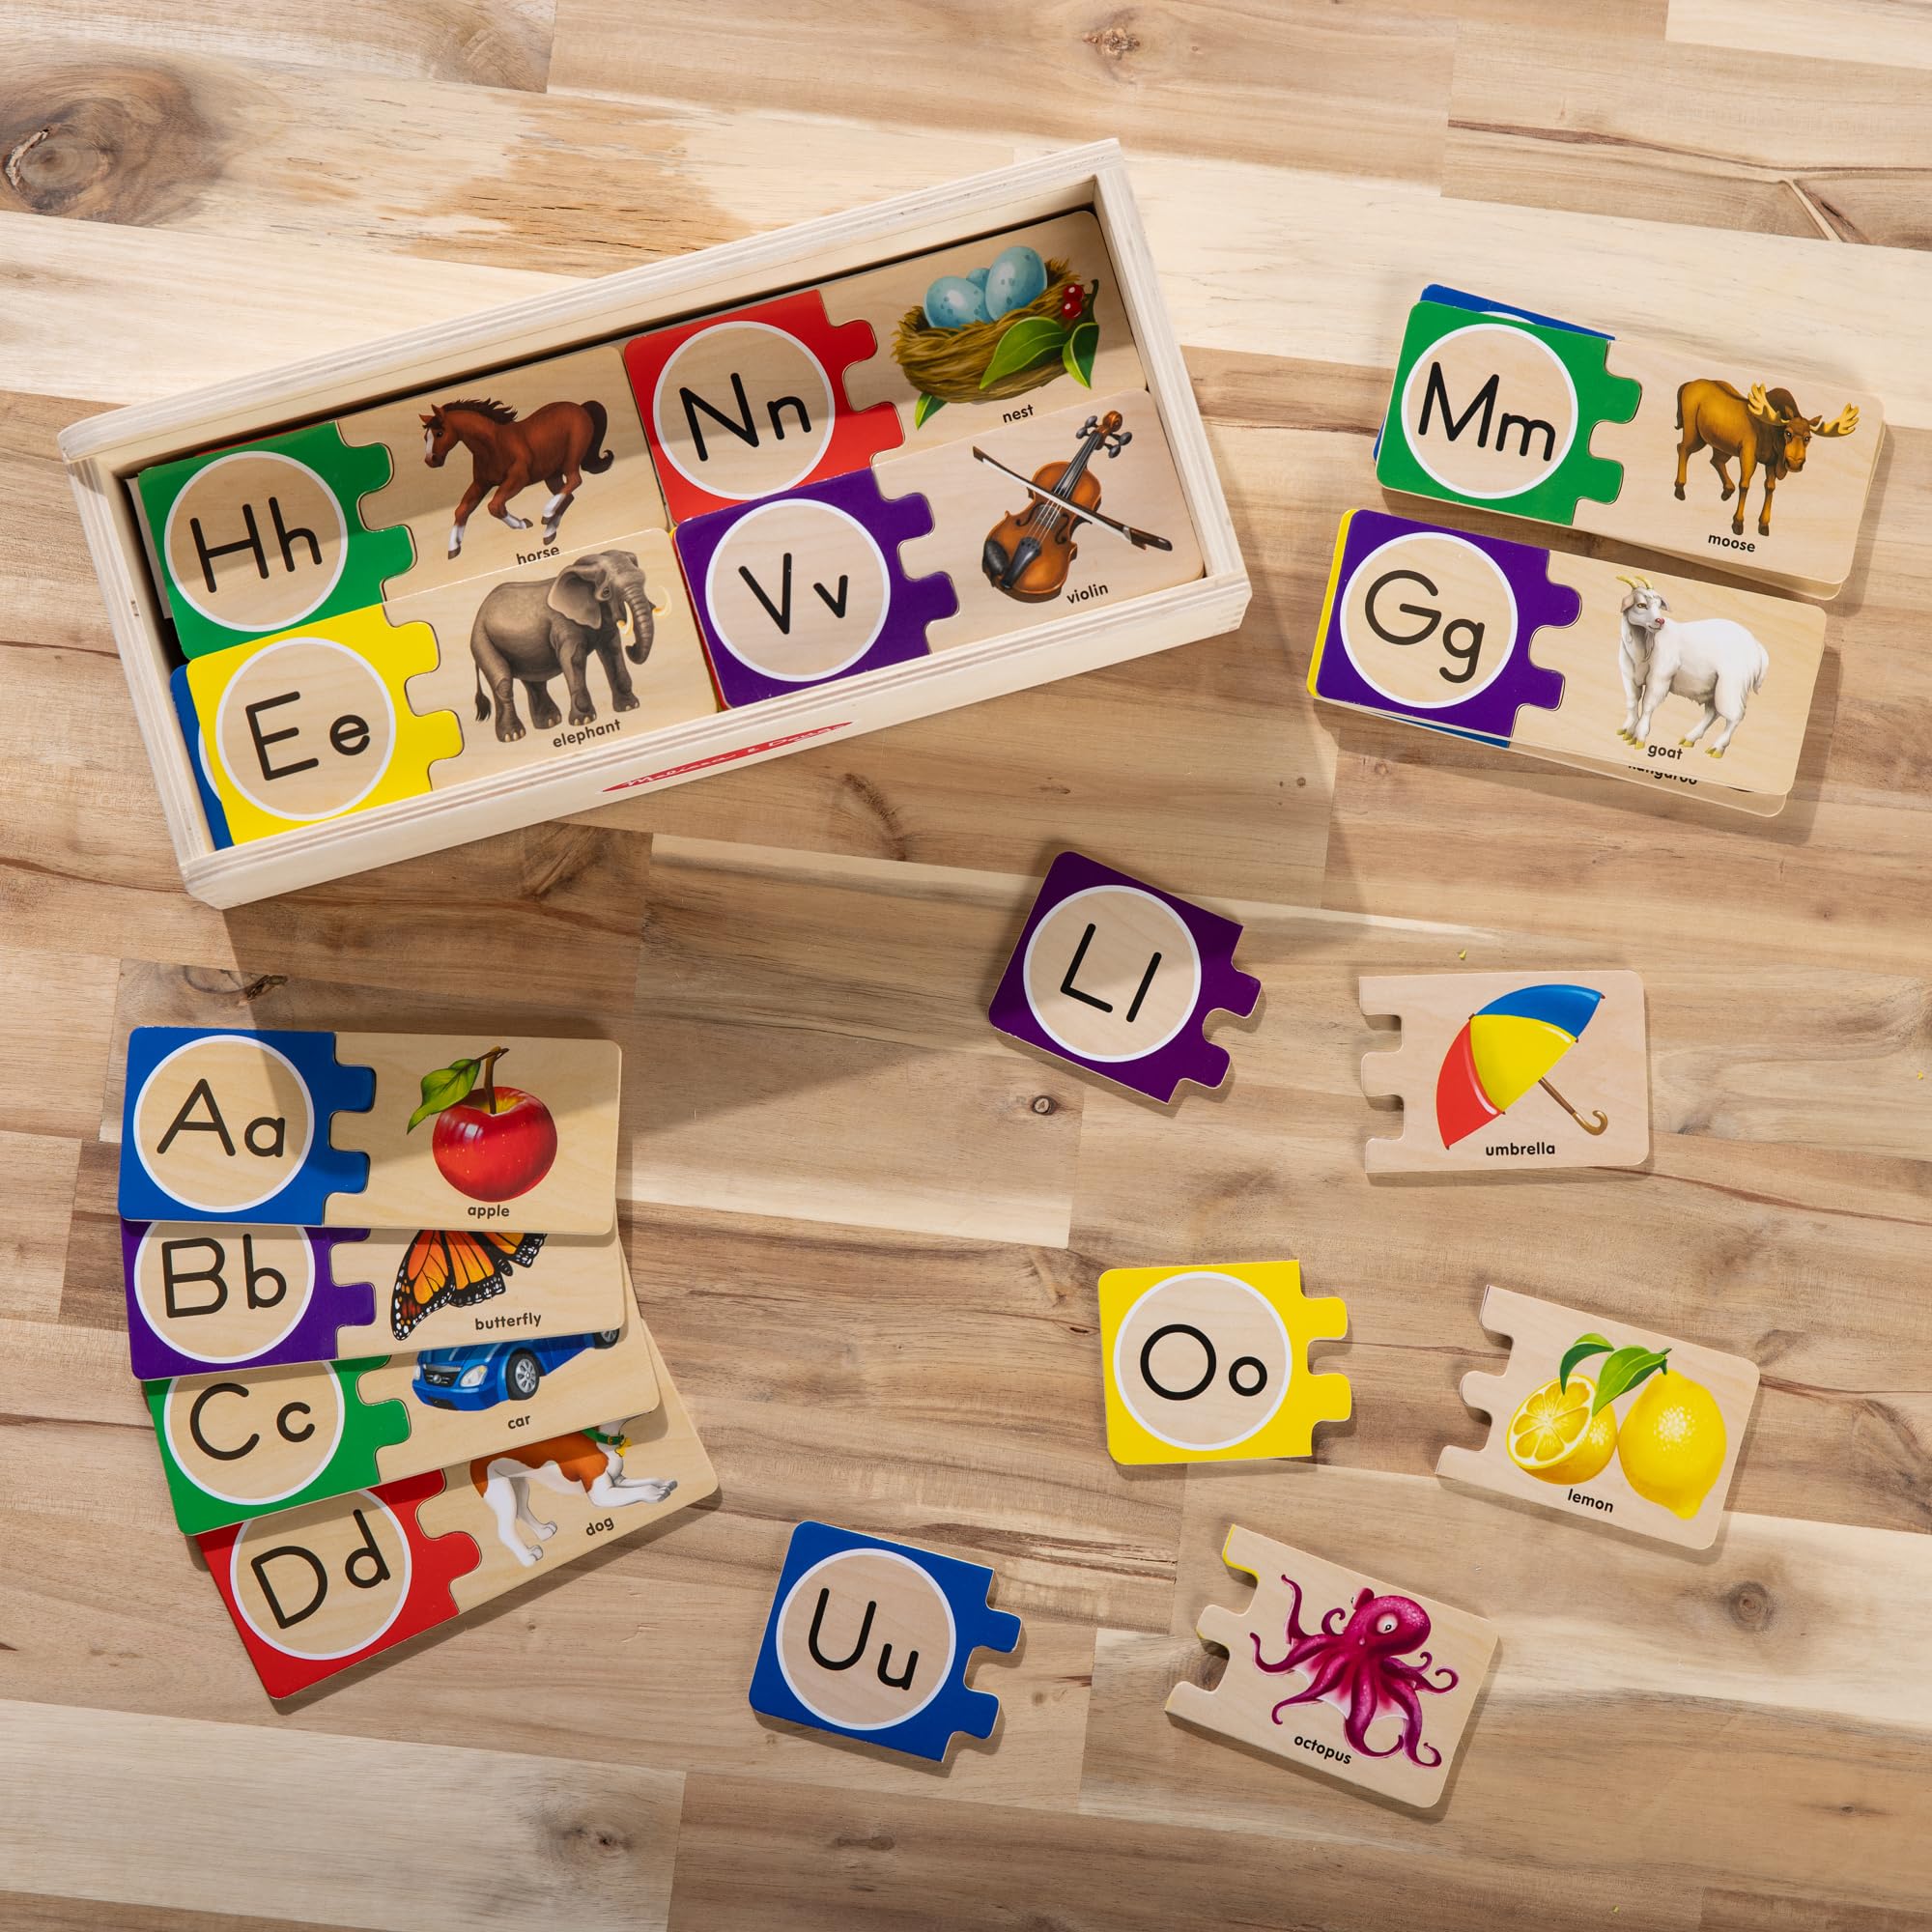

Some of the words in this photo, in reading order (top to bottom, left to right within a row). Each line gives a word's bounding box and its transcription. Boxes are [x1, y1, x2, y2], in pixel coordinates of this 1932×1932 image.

[1003, 405, 1033, 422] nest
[1709, 535, 1755, 552] moose
[516, 547, 560, 565] horse
[1067, 585, 1108, 603] violin
[553, 719, 620, 748] elephant
[1647, 745, 1683, 760] goat
[1486, 1142, 1554, 1155] umbrella
[469, 1205, 509, 1219] apple
[475, 1313, 541, 1329] butterfly
[508, 1416, 529, 1429] car
[1568, 1489, 1613, 1513] lemon
[586, 1519, 613, 1535] dog
[1294, 1736, 1351, 1765] octopus
